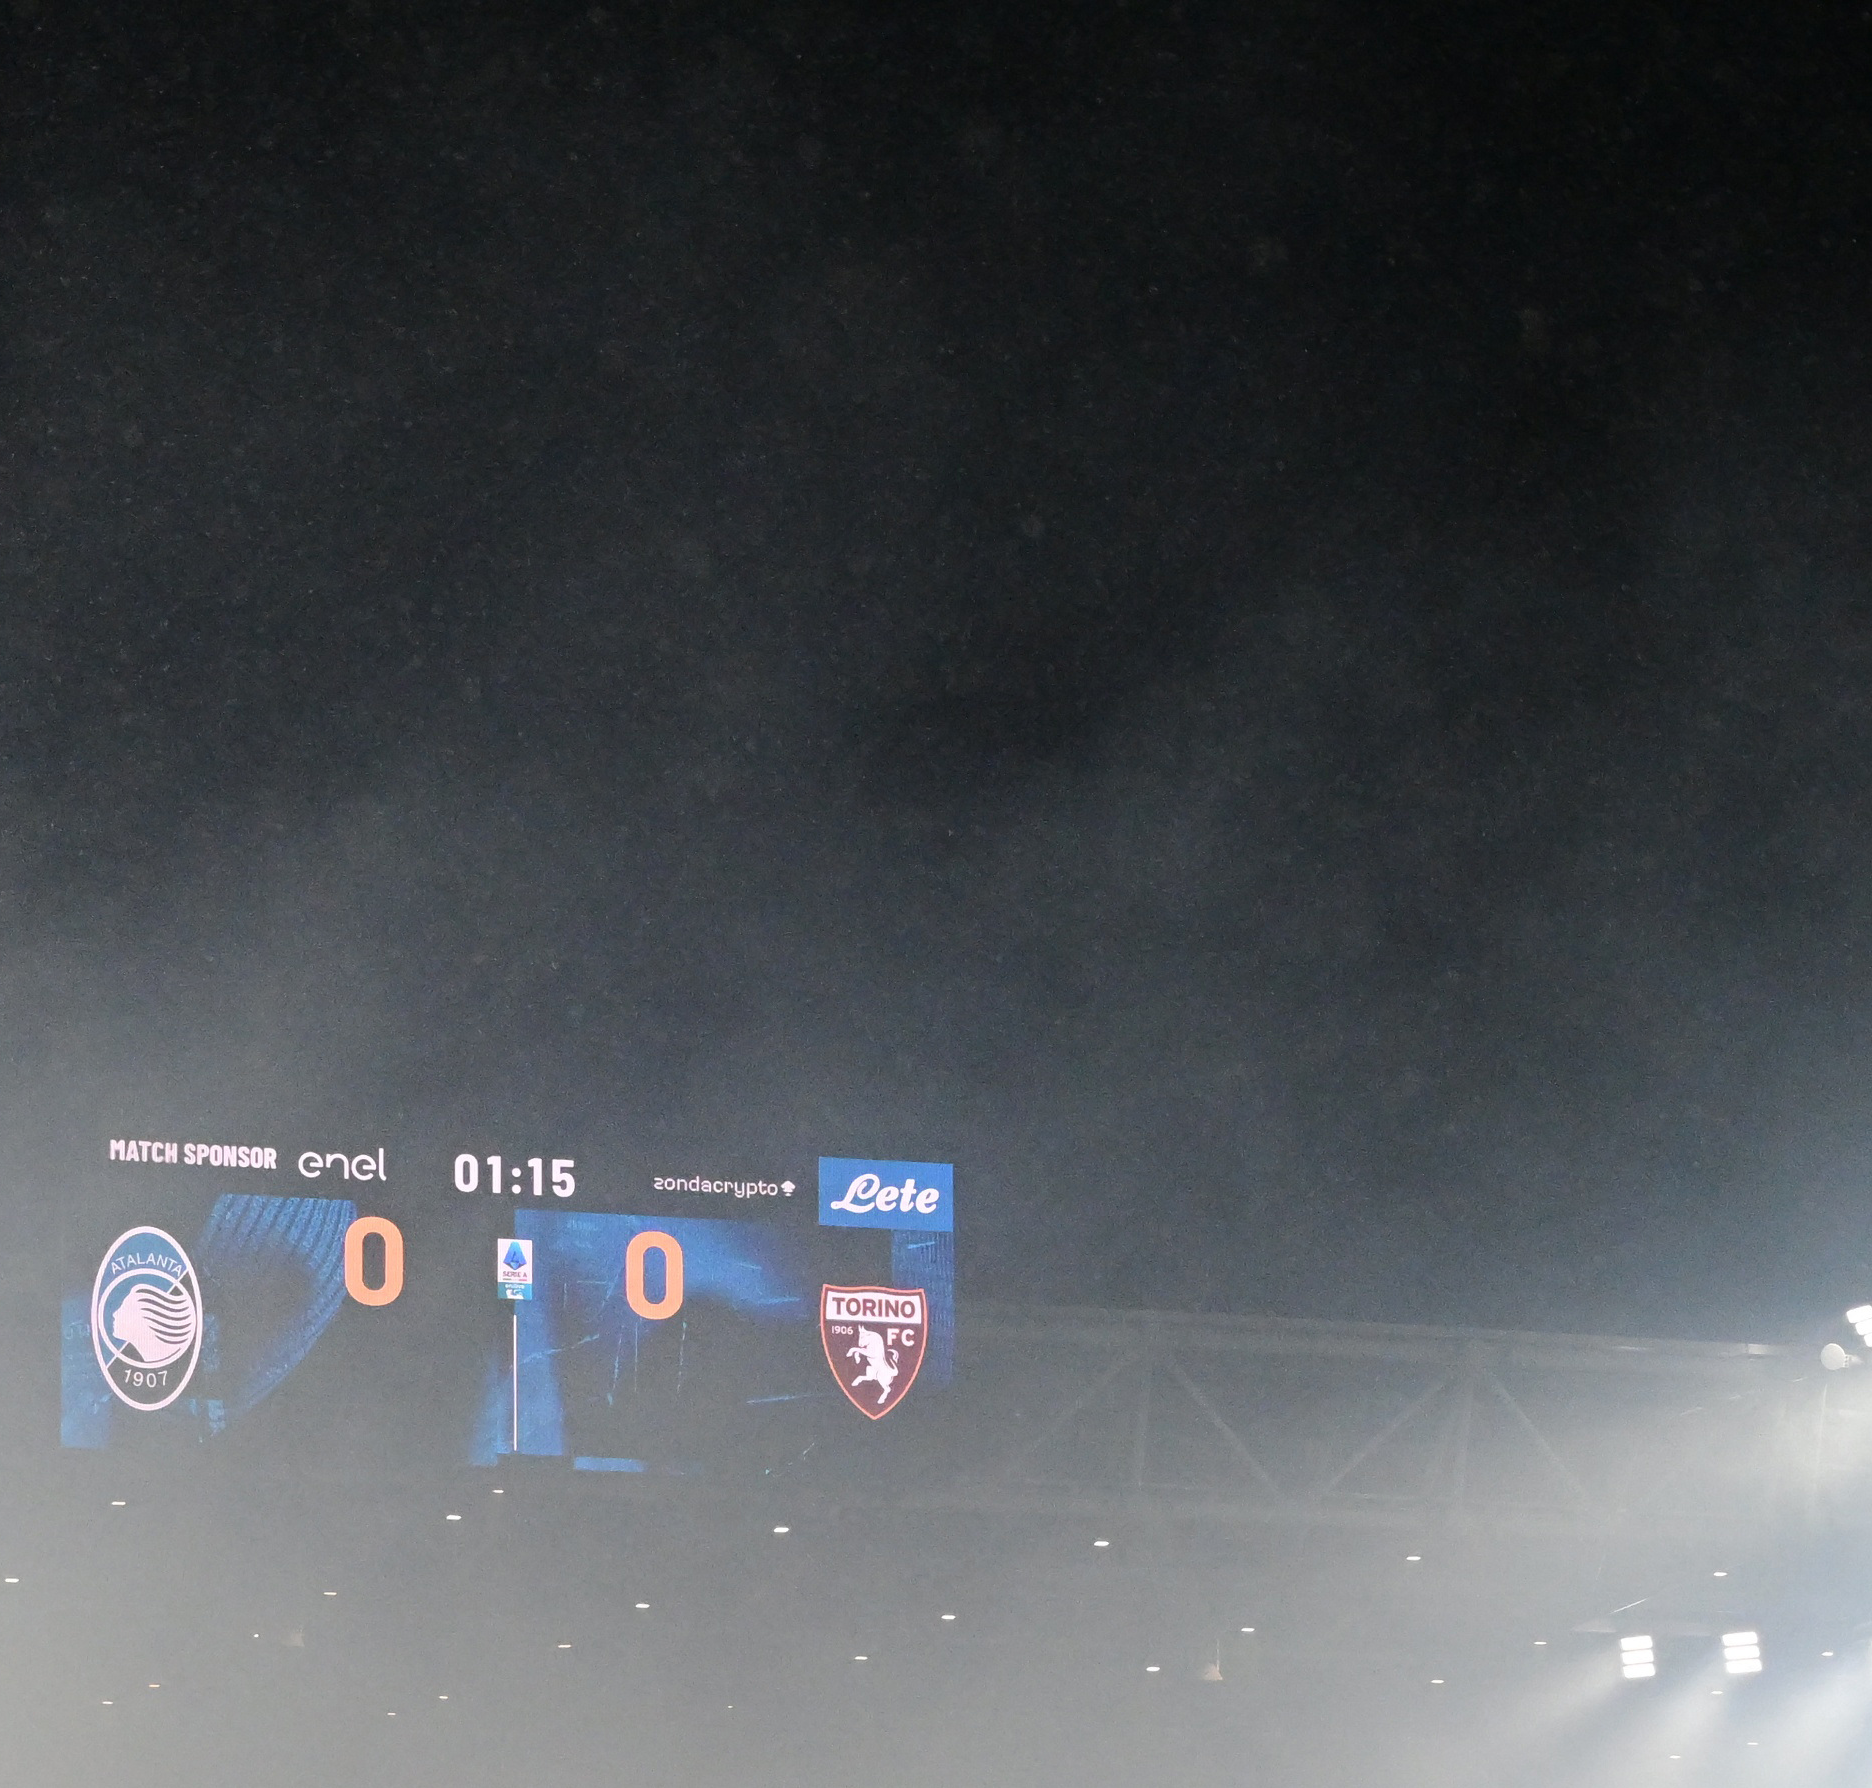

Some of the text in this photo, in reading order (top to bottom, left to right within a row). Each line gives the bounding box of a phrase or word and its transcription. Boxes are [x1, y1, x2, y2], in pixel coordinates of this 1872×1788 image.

[109, 1139, 277, 1169] MATCH SPONSOR
[298, 1148, 387, 1181] enel
[454, 1153, 575, 1198] 01:15
[653, 1176, 778, 1198] zondacrypto
[830, 1173, 940, 1214] Lete
[110, 1252, 184, 1277] ATALANTA
[344, 1216, 404, 1306] 0
[625, 1230, 684, 1320] 0
[831, 1297, 916, 1319] TORINO
[831, 1325, 854, 1336] 1906
[886, 1328, 916, 1347] FC
[124, 1369, 168, 1388] 1907
